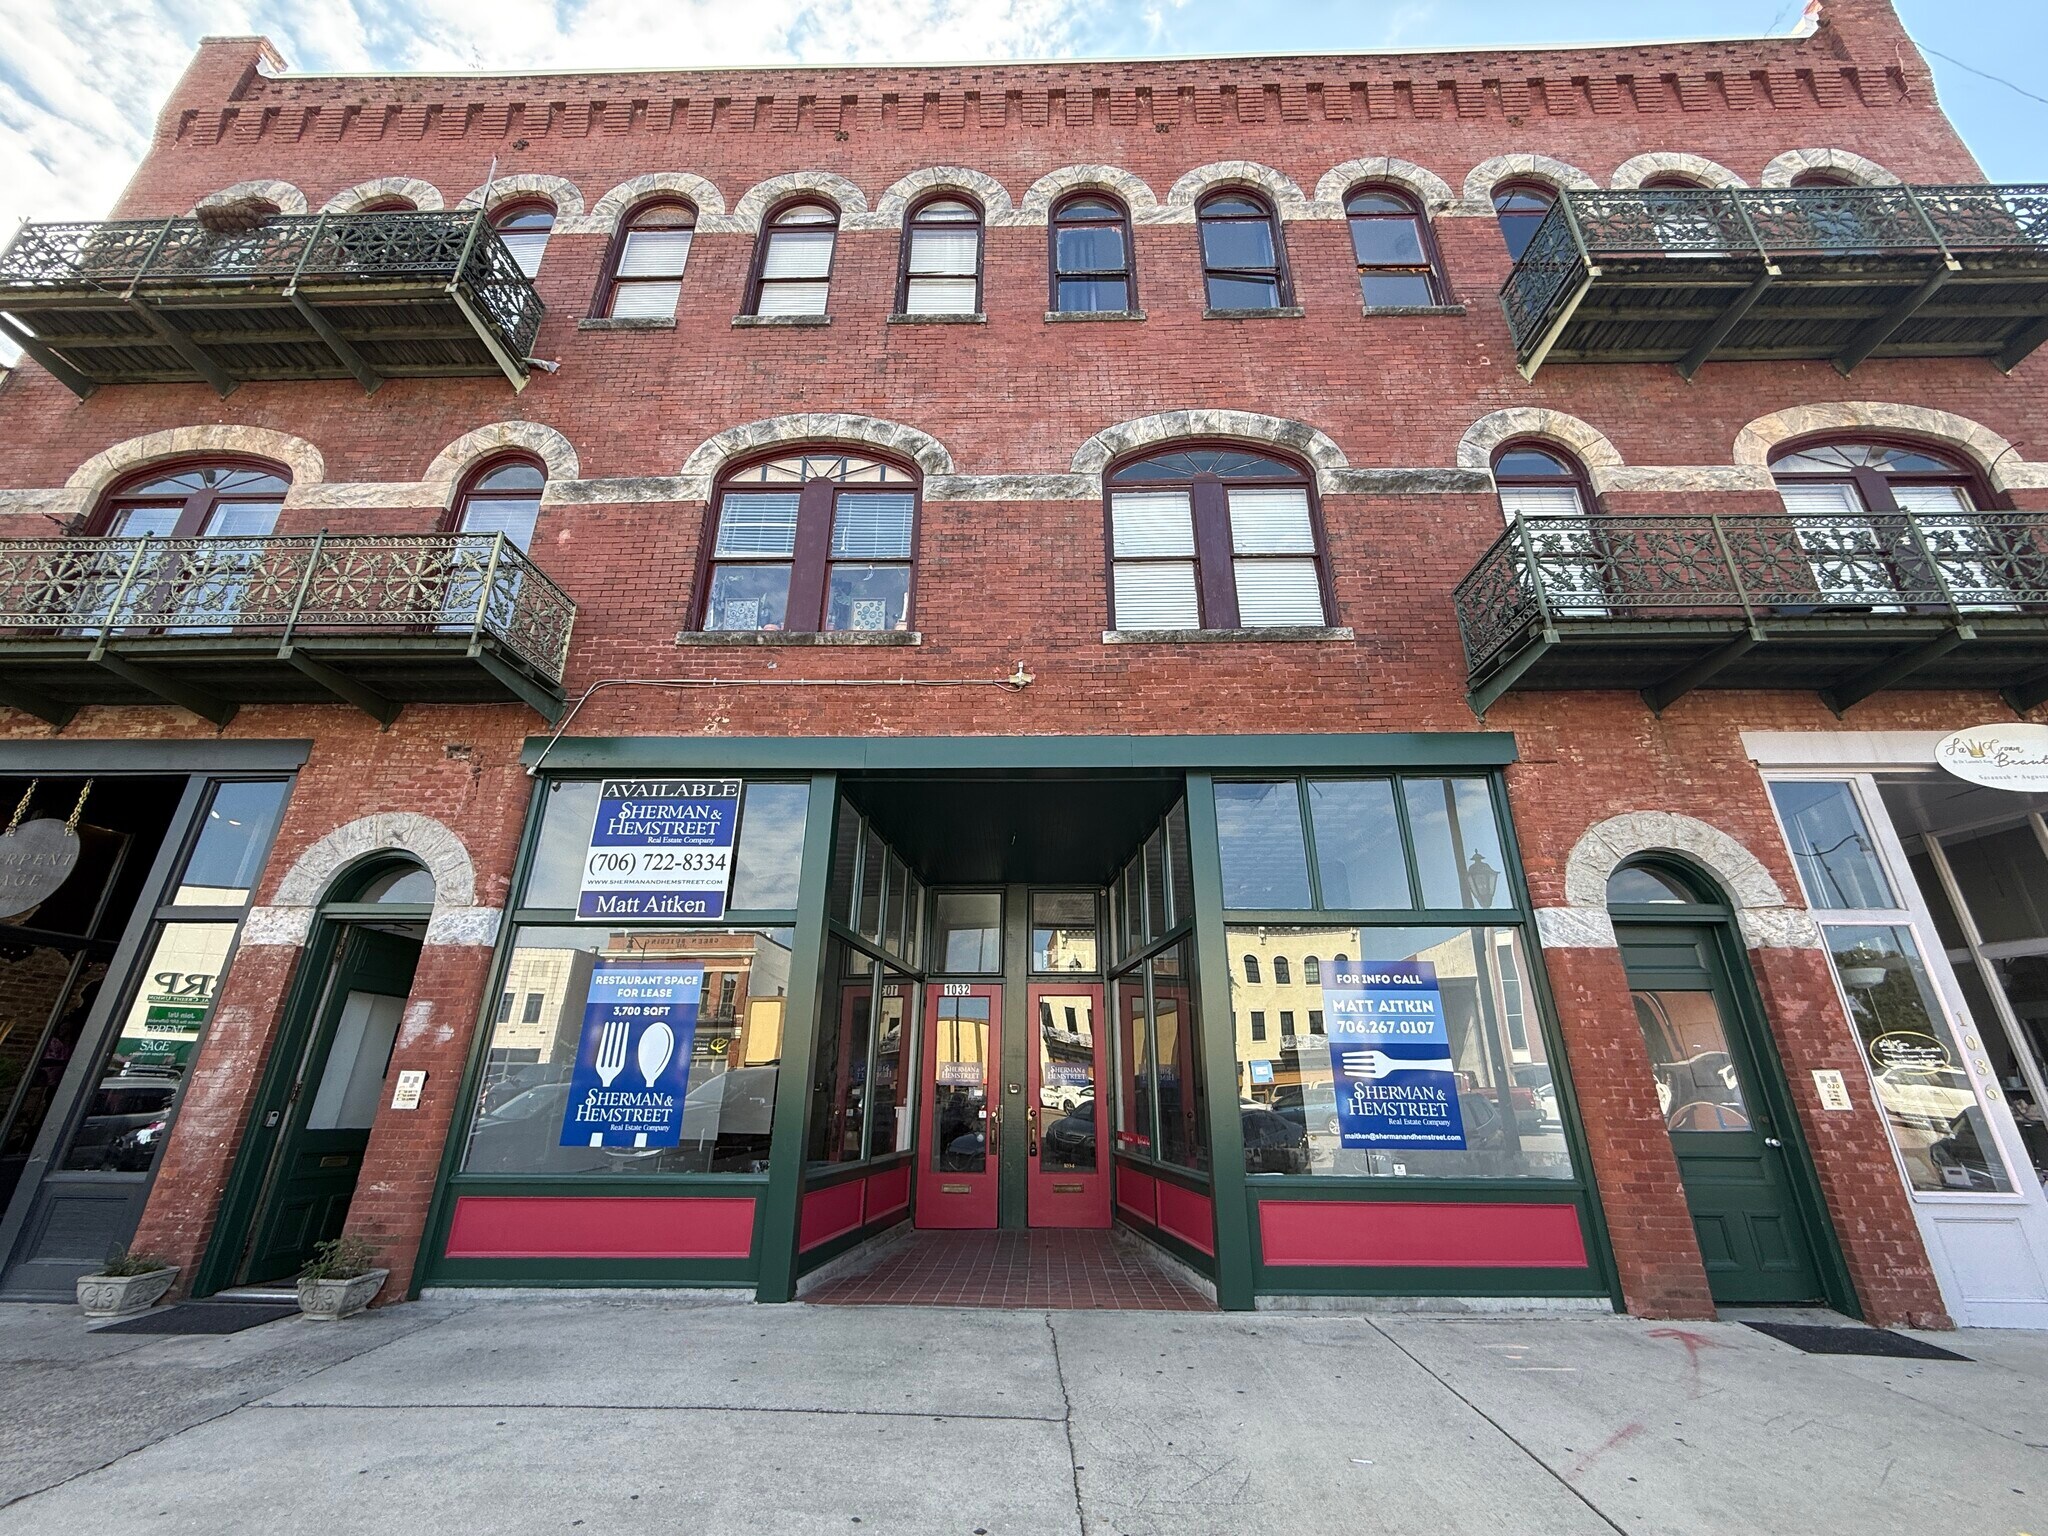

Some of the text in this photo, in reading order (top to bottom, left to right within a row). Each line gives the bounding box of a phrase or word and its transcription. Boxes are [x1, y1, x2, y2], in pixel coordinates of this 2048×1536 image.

[1994, 752, 2048, 768] Beaut
[602, 784, 738, 798] AVAILABLE
[618, 802, 722, 820] SHERMAN &
[606, 818, 720, 835] HEMSTREET
[684, 836, 715, 845] Company
[589, 853, 726, 876] (706) 722-8334
[596, 895, 706, 913] Matt Aitken
[596, 976, 698, 985] RESTAURANT SPACE
[1336, 974, 1423, 984] FOR INFO CALL
[617, 989, 672, 997] FOR LEASE
[945, 984, 970, 995] 1032
[613, 1007, 670, 1016] 3,700 SQFT
[1333, 1000, 1435, 1013] MATT AITKIN
[146, 1025, 186, 1033] ERPENT
[1337, 1020, 1435, 1034] 706.267.0107
[140, 1040, 172, 1051] SAGE
[586, 1088, 673, 1106] SHERMAN &
[1354, 1082, 1446, 1101] SHERMAN &
[575, 1104, 673, 1122] HEMSTREET
[1348, 1099, 1448, 1116] HEMSTREET
[643, 1124, 670, 1132] Company
[1423, 1118, 1450, 1127] Company
[1344, 1132, 1462, 1142] maitken@shermanandhemstreet.com
